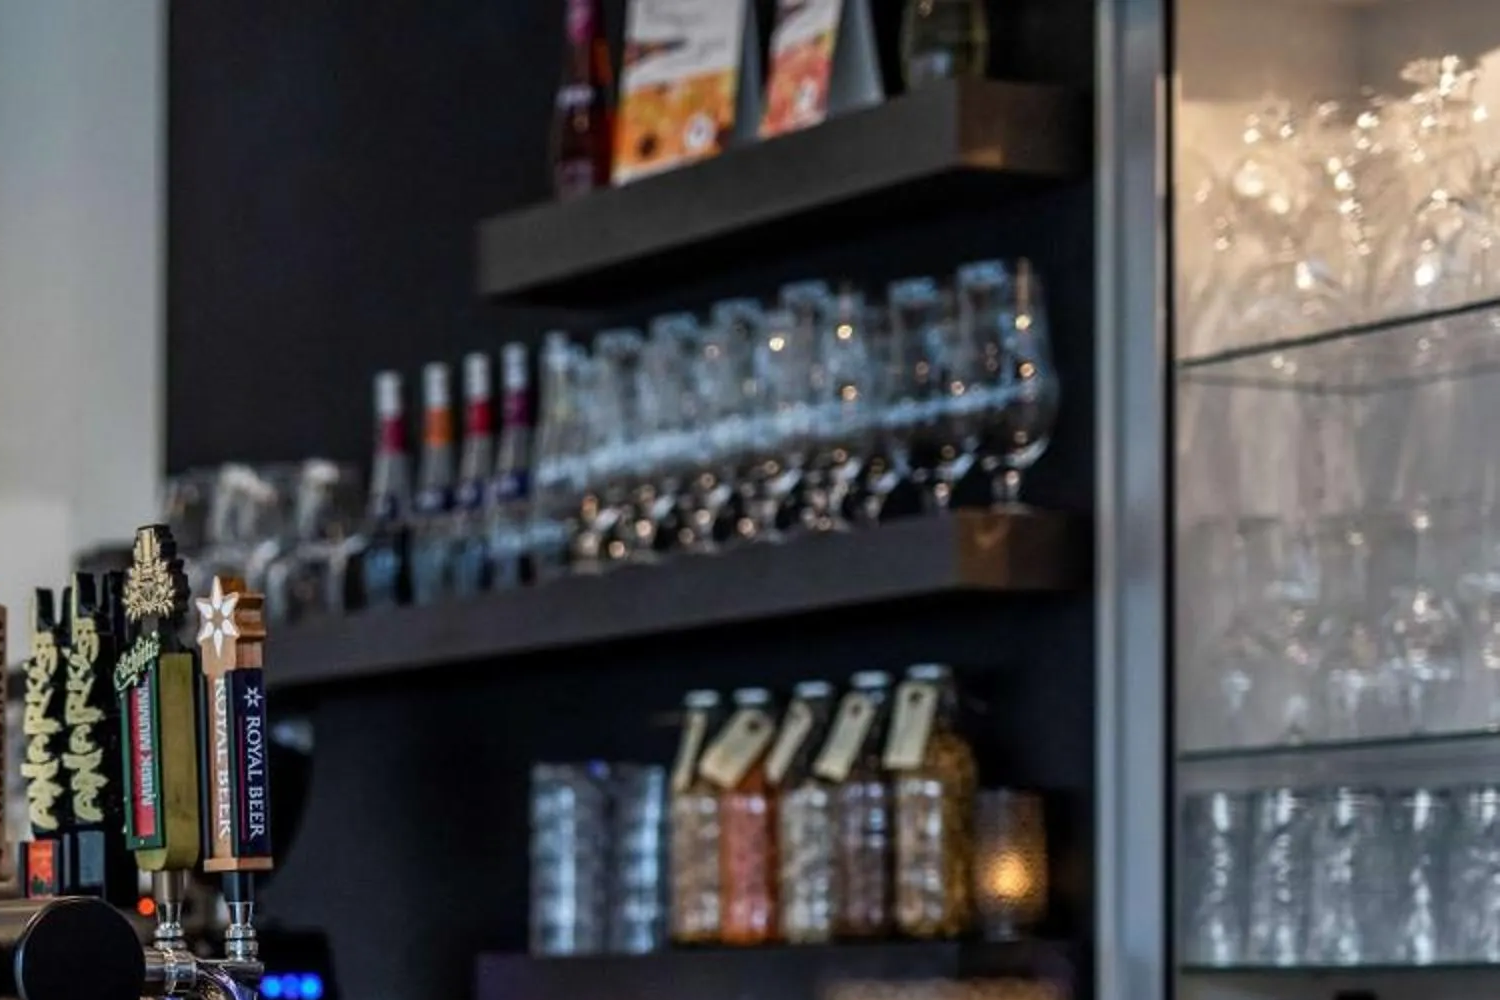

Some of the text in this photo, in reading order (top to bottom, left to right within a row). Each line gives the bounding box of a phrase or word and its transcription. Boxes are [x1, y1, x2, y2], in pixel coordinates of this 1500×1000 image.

[216, 770, 231, 838] BEER
[244, 715, 265, 840] ROYAL BEER
